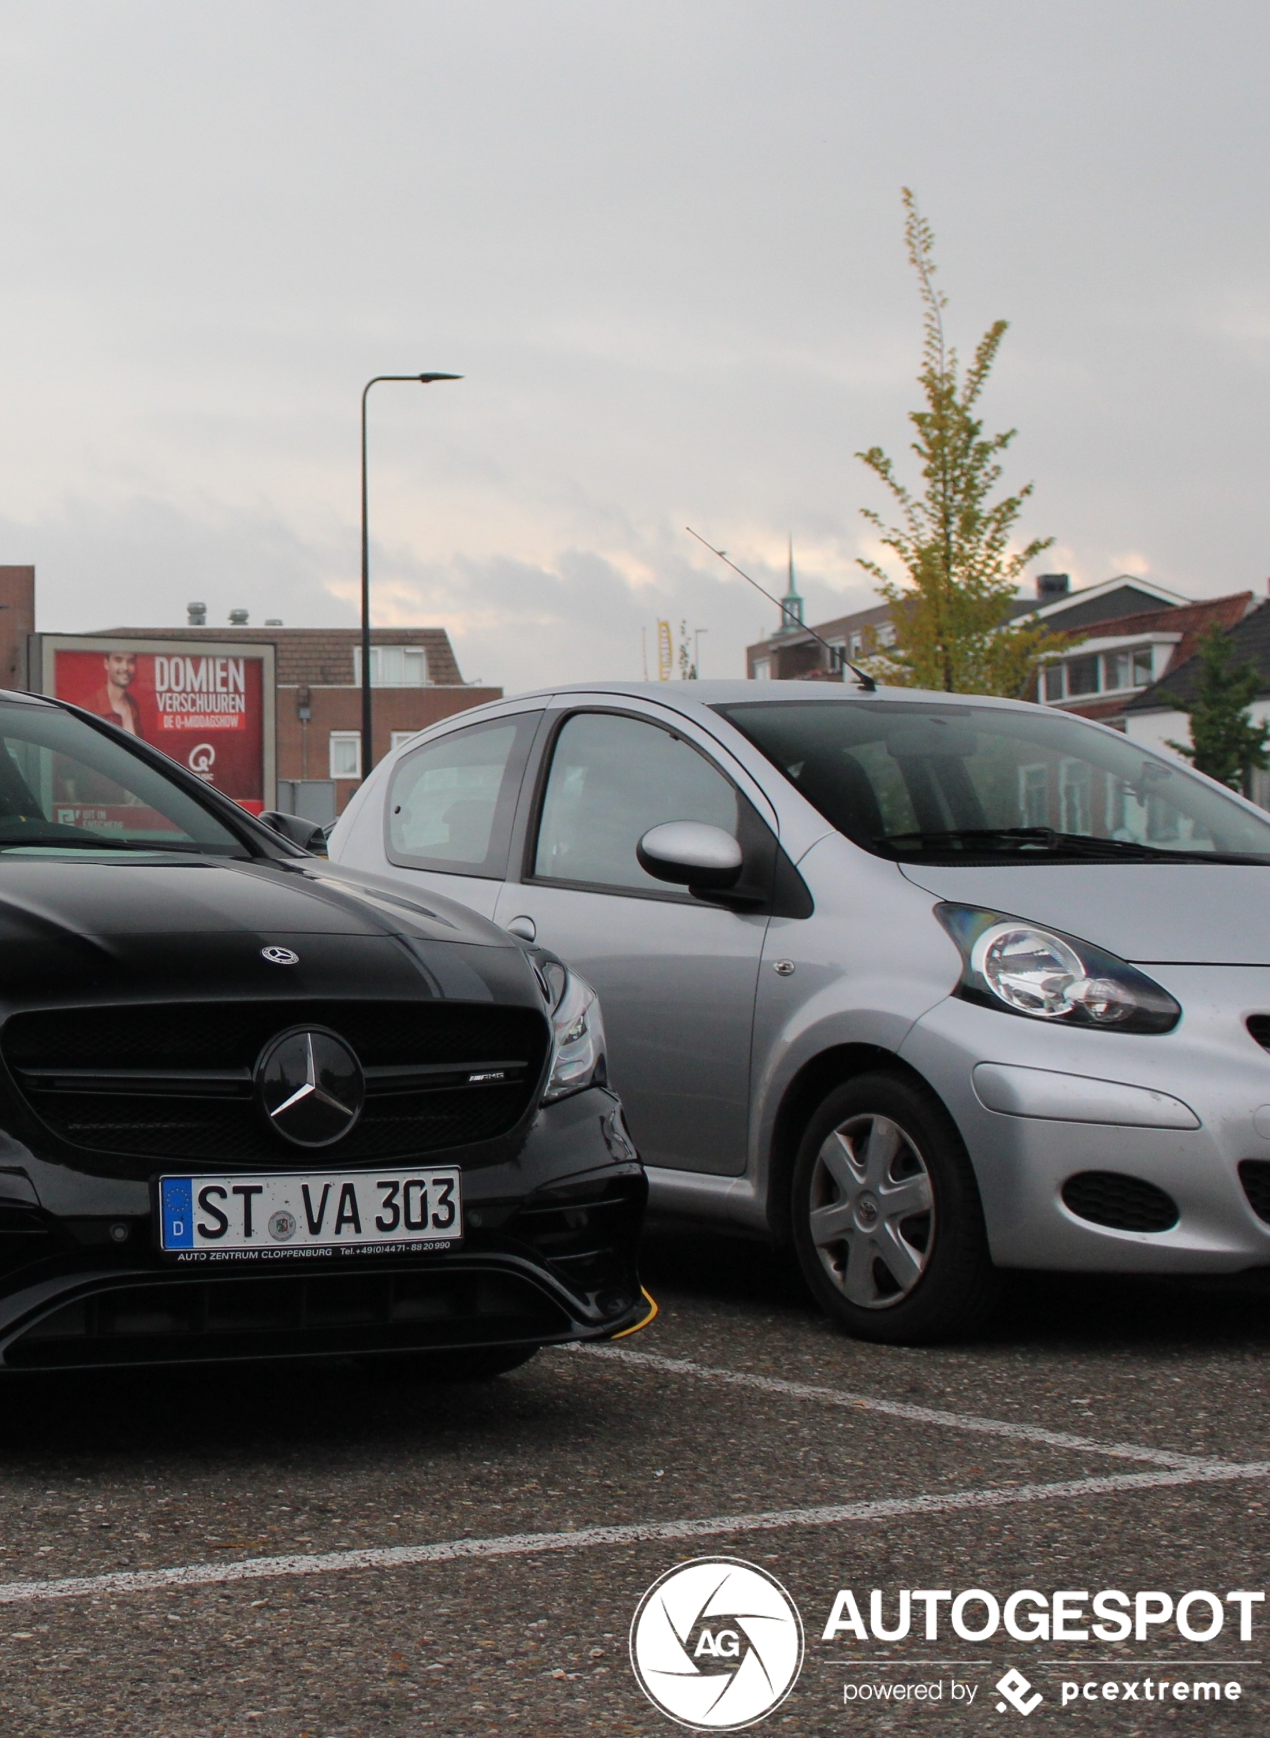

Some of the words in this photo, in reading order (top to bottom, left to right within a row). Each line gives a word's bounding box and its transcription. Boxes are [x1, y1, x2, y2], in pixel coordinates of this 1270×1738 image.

[155, 656, 245, 693] DOMIEN
[155, 693, 245, 713] VERSCHUUREN
[163, 715, 174, 729] DE
[175, 715, 239, 729] Q-MIDDAGSHOW
[196, 1184, 263, 1239] ST
[301, 1182, 362, 1235] VA
[375, 1177, 456, 1233] 303
[172, 1221, 184, 1236] D
[177, 1252, 207, 1261] AUTO
[209, 1251, 258, 1261] ZENTRUM
[261, 1248, 333, 1260] CLOPPENBURG
